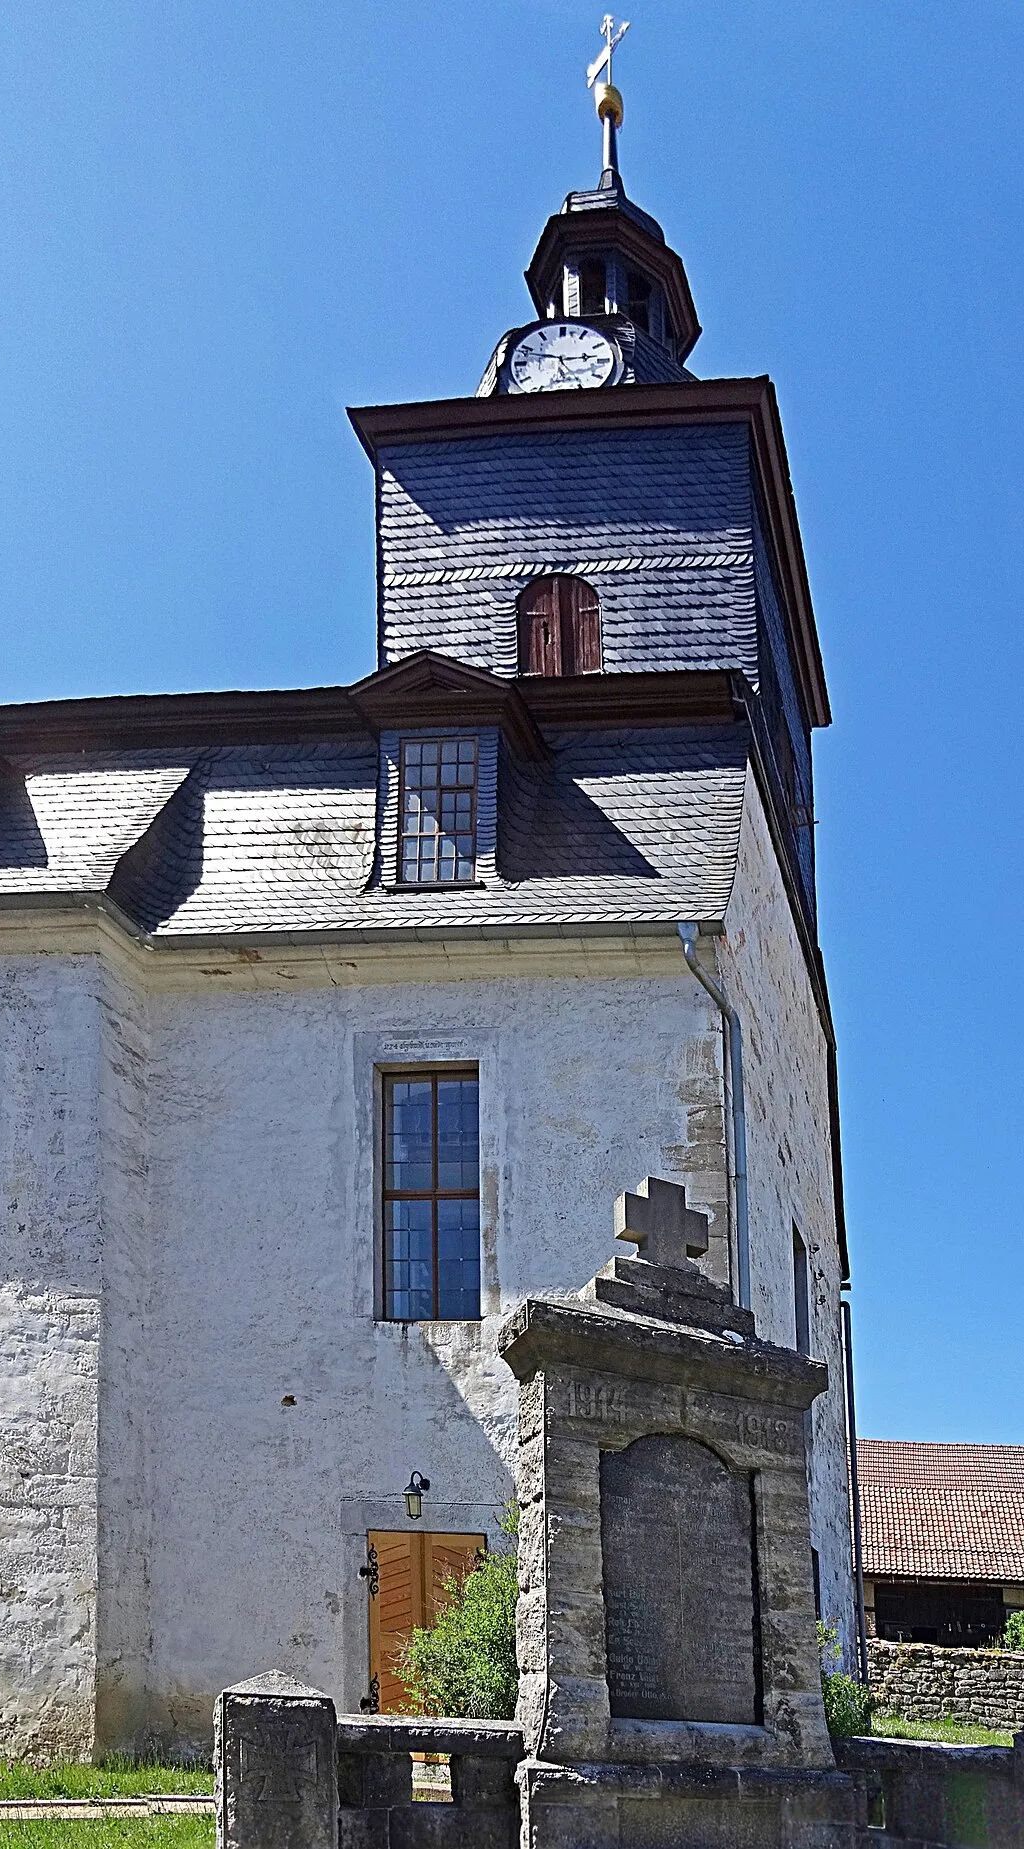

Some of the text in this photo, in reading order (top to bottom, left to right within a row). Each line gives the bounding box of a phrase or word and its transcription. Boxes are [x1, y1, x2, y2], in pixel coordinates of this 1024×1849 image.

[566, 1380, 792, 1452] 1914 1918
[610, 1670, 635, 1681] Franz
